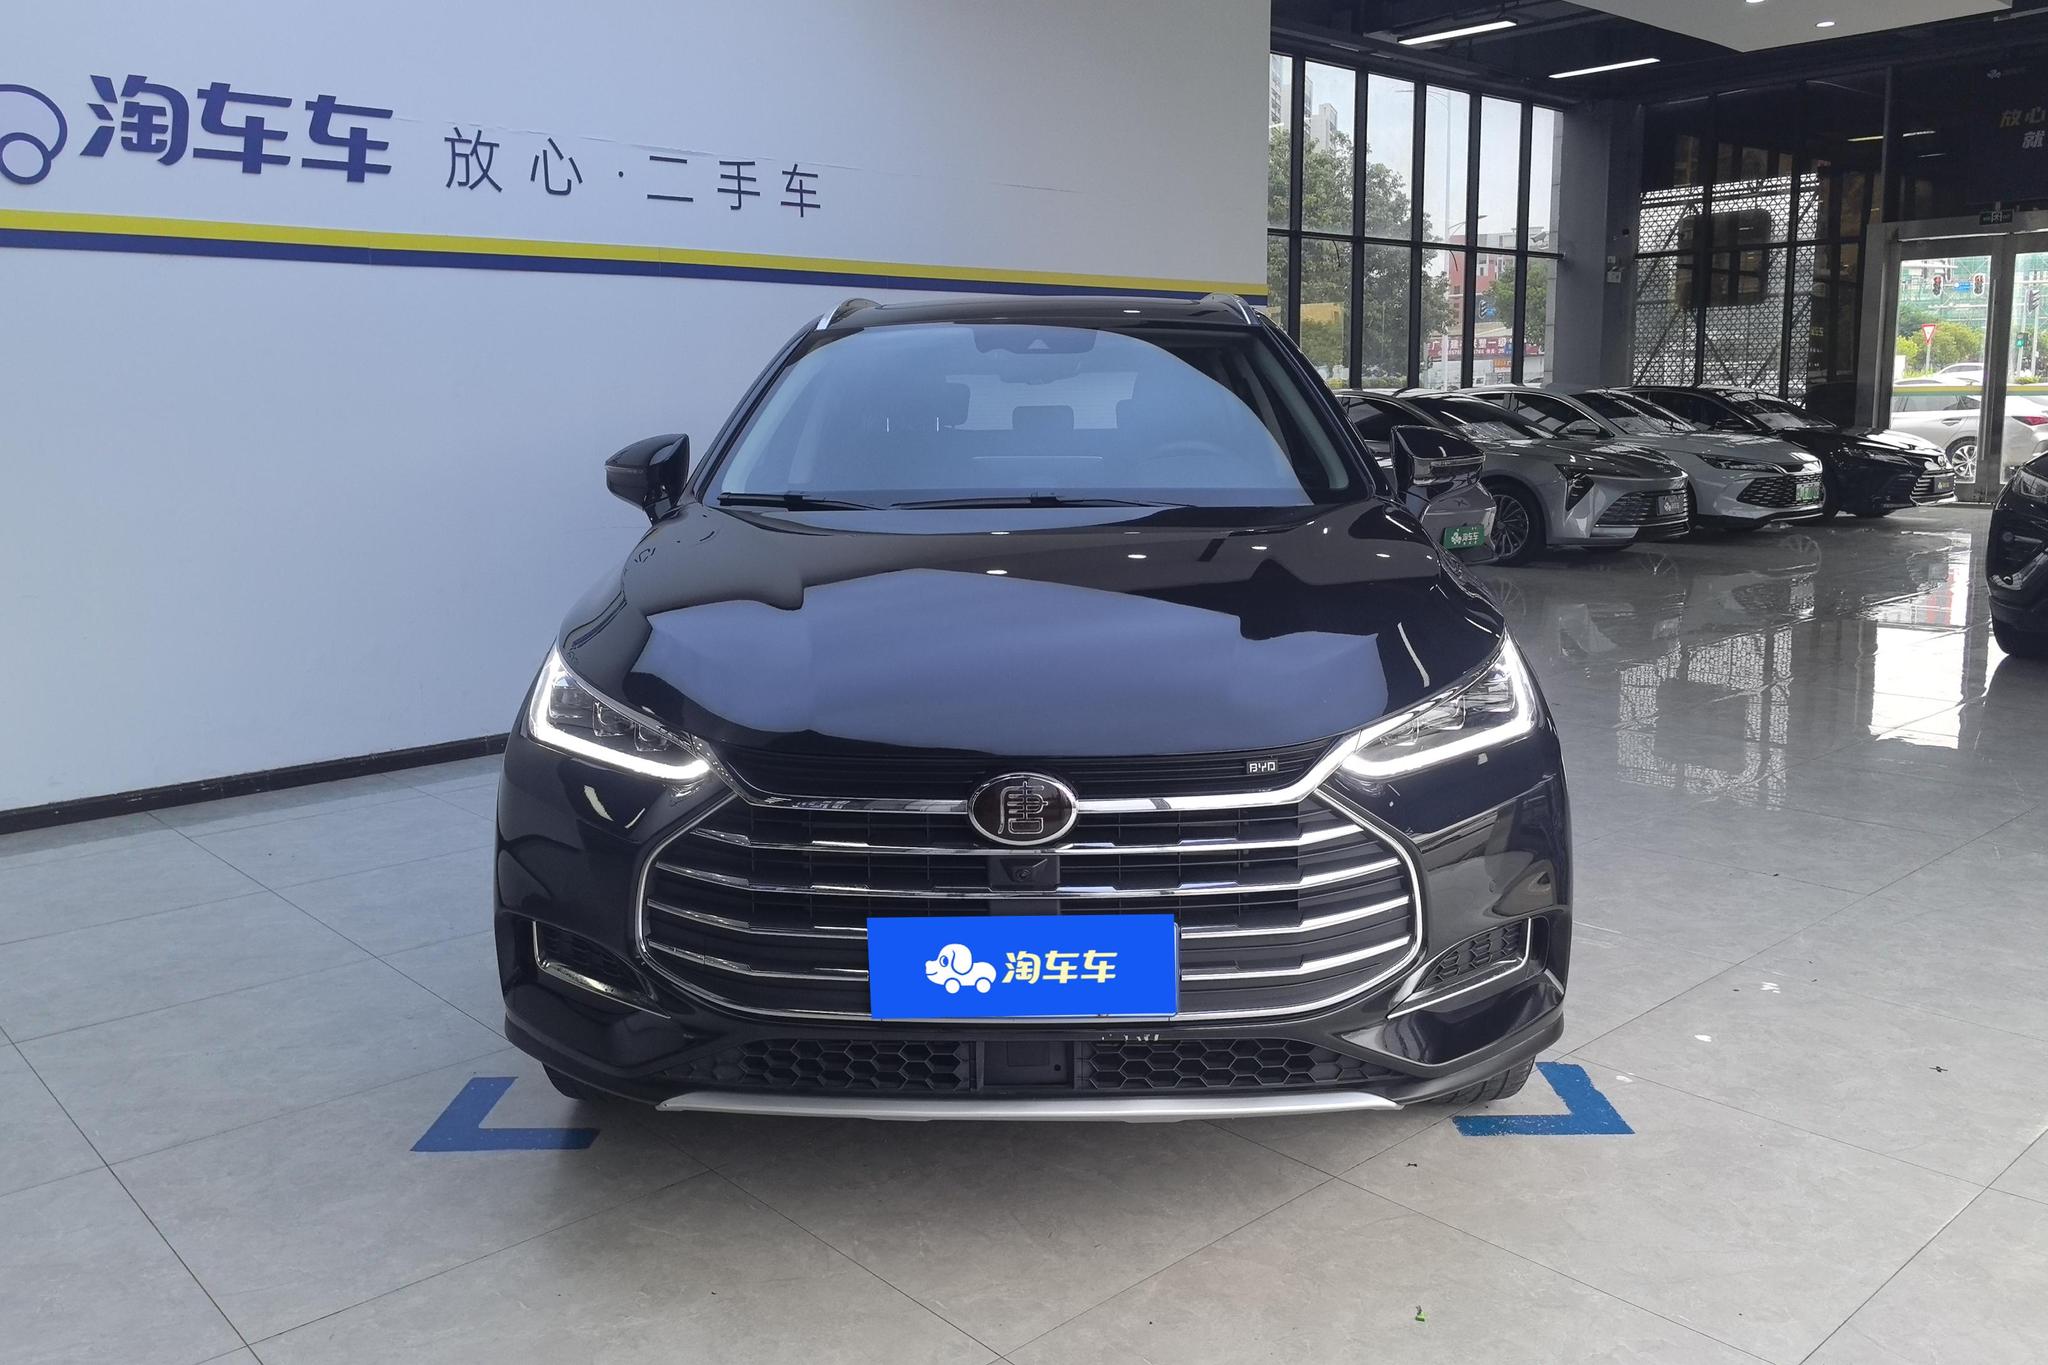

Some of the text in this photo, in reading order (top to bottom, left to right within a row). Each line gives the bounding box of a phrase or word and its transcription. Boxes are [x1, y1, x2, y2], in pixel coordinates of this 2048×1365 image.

[80, 73, 393, 184] 淘车车
[1249, 761, 1276, 773] BYD
[997, 781, 1048, 835] 唐
